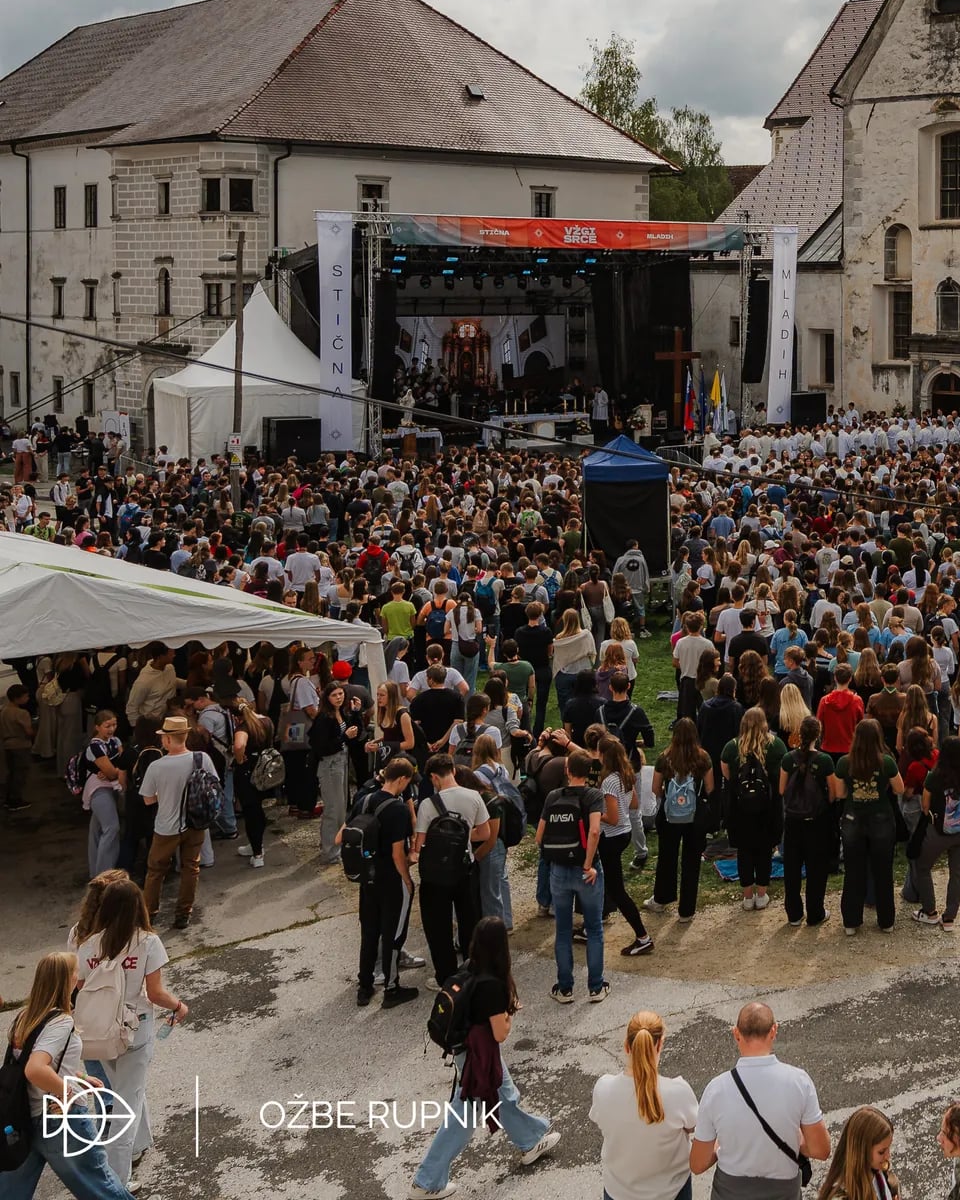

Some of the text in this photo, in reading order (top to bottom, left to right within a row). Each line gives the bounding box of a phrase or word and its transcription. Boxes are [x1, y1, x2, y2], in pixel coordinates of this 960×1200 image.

[479, 228, 510, 237] STIČNA
[564, 225, 595, 235] VŽGI
[563, 234, 597, 244] SRCE
[778, 269, 791, 380] MLADIH
[331, 264, 344, 398] STIČNA
[550, 813, 574, 823] NASA
